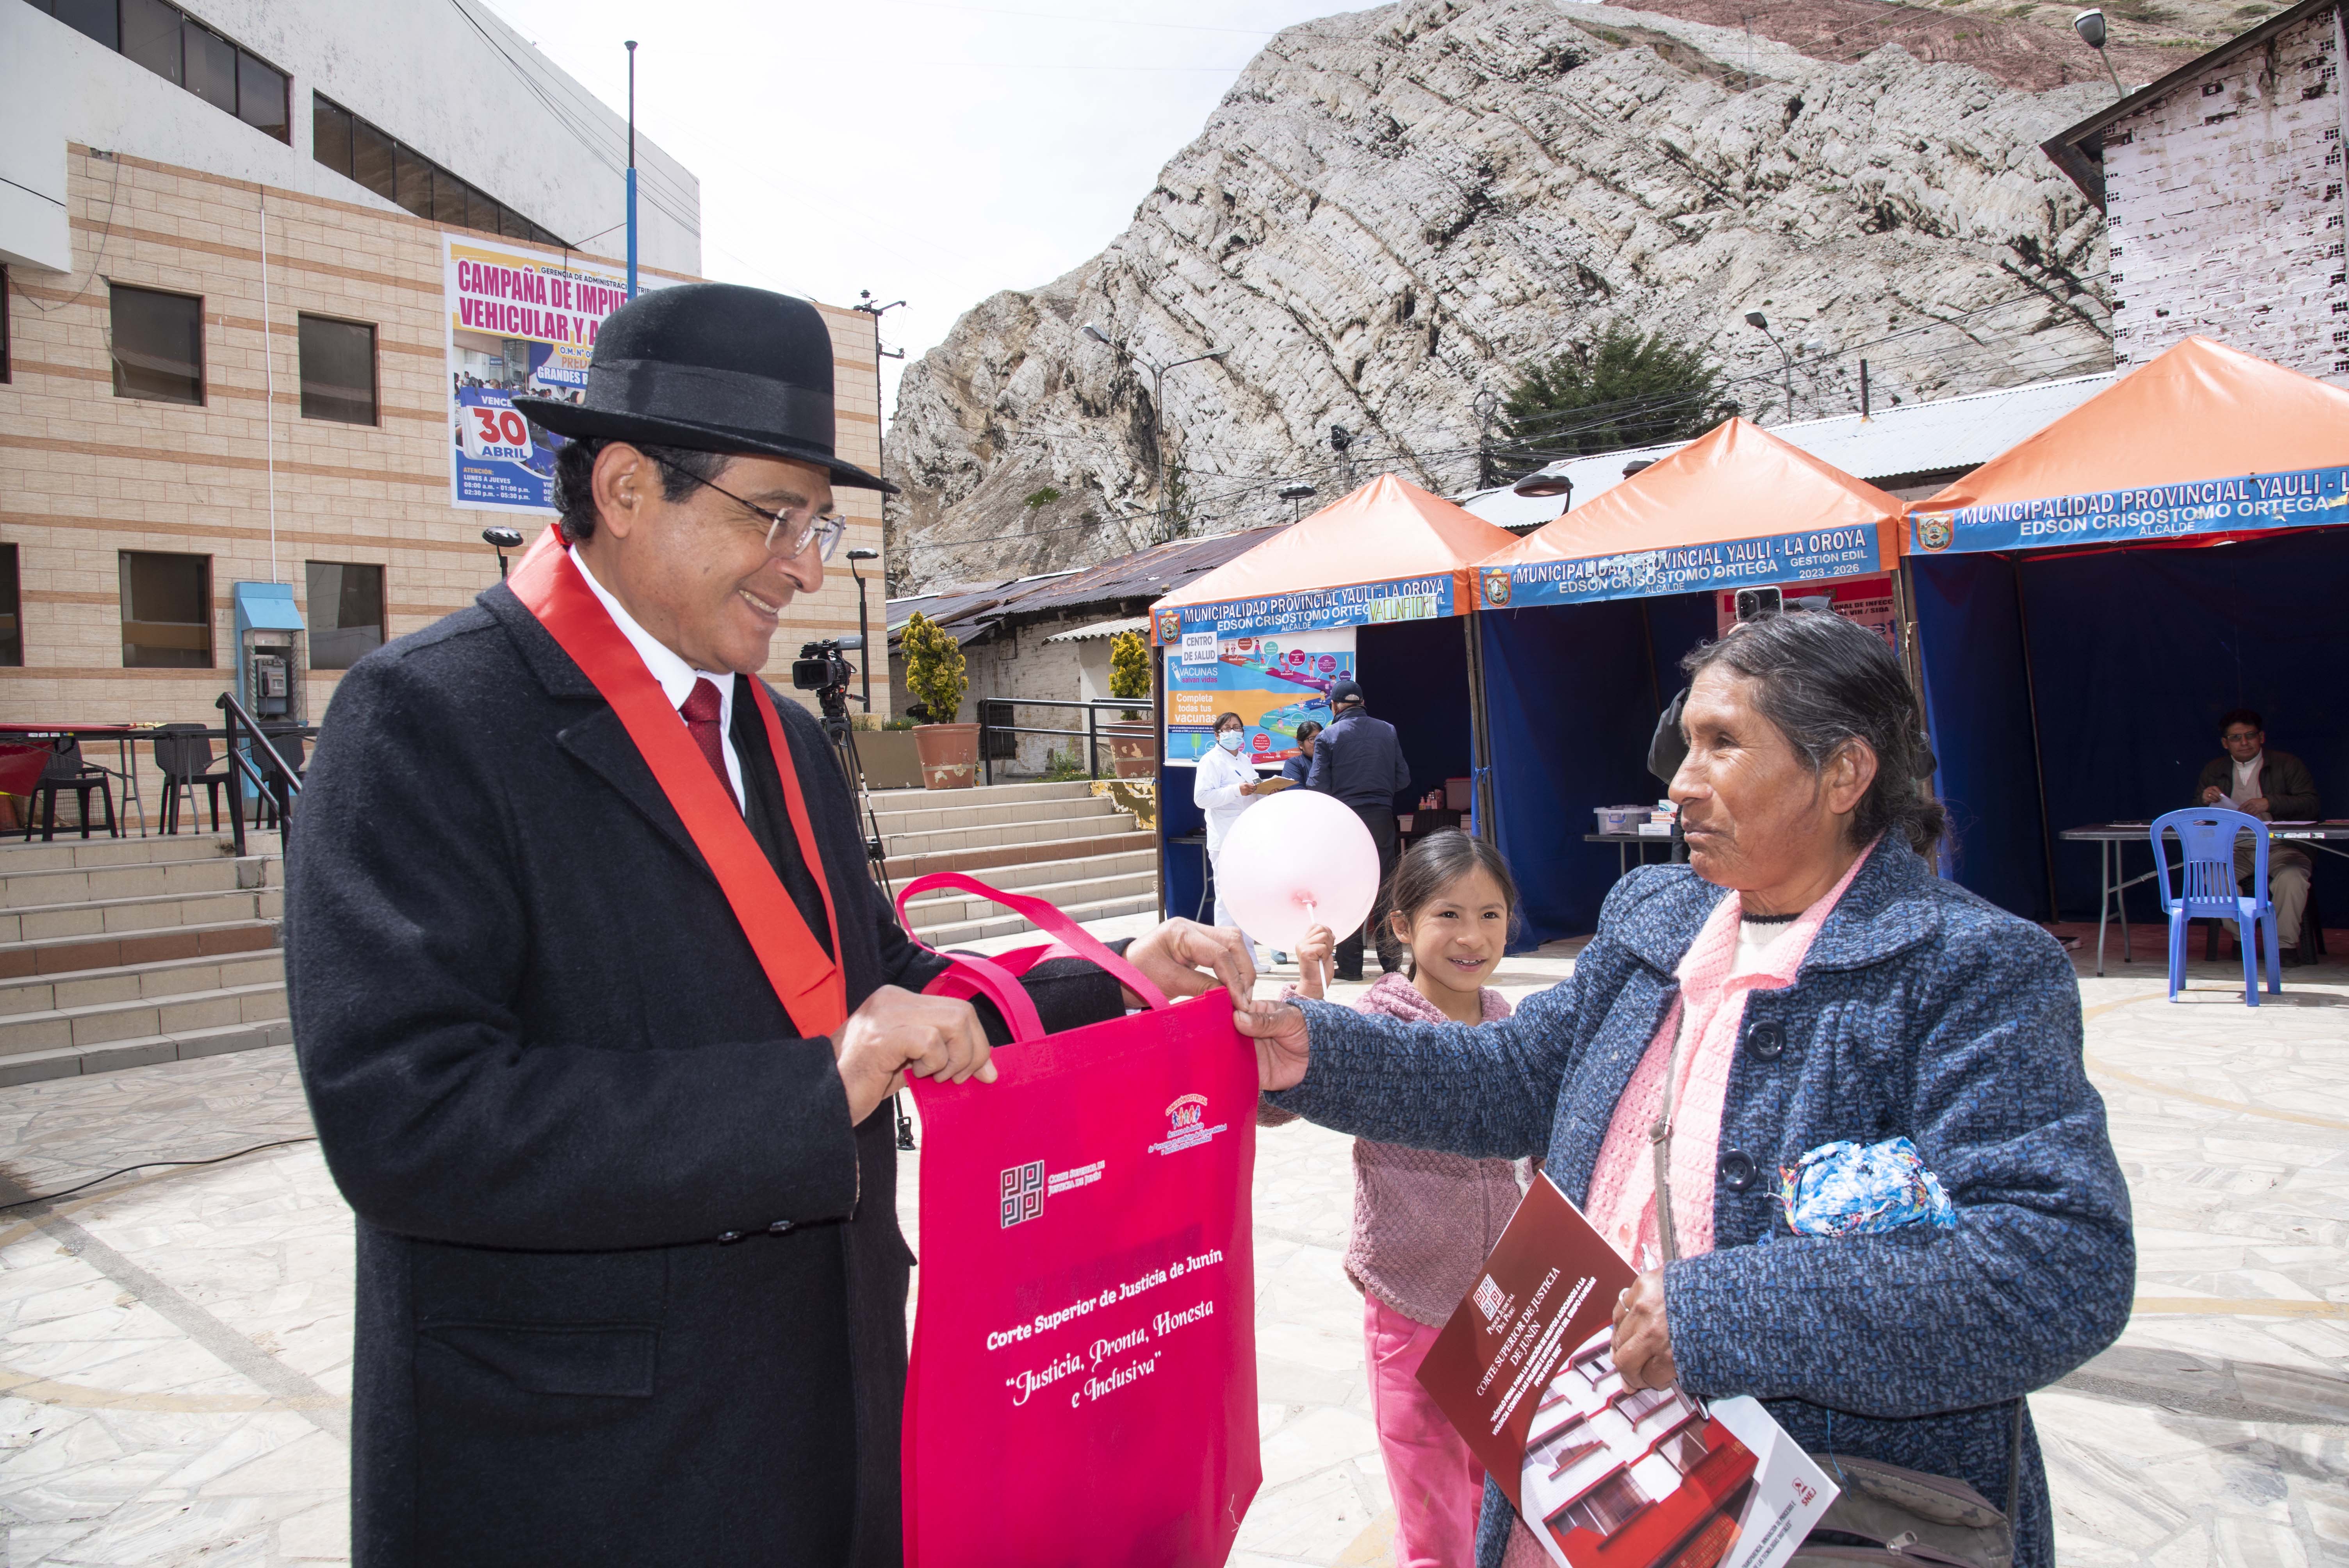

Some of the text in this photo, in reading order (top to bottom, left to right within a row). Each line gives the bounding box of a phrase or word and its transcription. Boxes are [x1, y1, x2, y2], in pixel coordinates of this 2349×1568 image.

[458, 260, 572, 310] CAMPAÑA DE
[541, 267, 573, 279] GERENCIA
[584, 276, 627, 290] ADMINISTRACI
[459, 297, 585, 344] VEHICULAR Y
[560, 347, 575, 356] O.M.
[537, 366, 581, 383] GRANDES
[481, 396, 513, 407] VENCE
[473, 407, 526, 446] 30
[481, 445, 528, 459] ABRIL
[463, 467, 494, 475] ATENCIÓN:
[1961, 473, 2320, 526] MUNICIPALIDAD PROVINCIAL YAULI
[2020, 496, 2329, 536] EDSON CRISOSTOMO ORTEGA
[2139, 522, 2195, 536] ALCALDE
[1516, 529, 1866, 584] MUNICIPALIDAD PROVINCIAL YAULI LA OROYA
[1559, 550, 1868, 594] EDSON CRISOSTOMO ORTEGA GESTION EDIL
[1645, 563, 1859, 594] ALCALDE 2023 2026
[1185, 600, 1267, 623] MUNICIPALIDAD
[1271, 592, 1338, 613] PROVINCIAL
[1403, 579, 1445, 596] OROYA
[1217, 608, 1330, 631] EDSON CRISOSTOMO
[1281, 622, 1312, 632] ALCALDE
[1187, 636, 1213, 647] CENTRO
[1184, 650, 1215, 661] DE SALUD
[1179, 667, 1218, 676] VACUNAS
[1176, 693, 1213, 704] Completa
[1175, 714, 1217, 723] vacunas
[1187, 1094, 1207, 1105] DISTRITAL
[987, 1249, 1223, 1351] Corte Superior de Justicia de Junín
[1578, 1276, 1597, 1302] FAMILIAR
[1567, 1299, 1581, 1319] GRUPO
[1476, 1267, 1560, 1396] CORTE SUPERIOR DE JUSTICIA
[1503, 1385, 1517, 1402] PENAL
[1513, 1372, 1525, 1388] PARA
[1521, 1365, 1529, 1375] LA
[1526, 1341, 1543, 1368] SANCIÓN
[1539, 1336, 1547, 1346] DE
[1543, 1317, 1559, 1340] DELITOS
[1556, 1288, 1578, 1320] ASOCIADOS
[1577, 1277, 1586, 1286] LA
[1510, 1320, 1541, 1366] DE JUNÍN
[1541, 1324, 1565, 1360] INTEGRANTES
[1006, 1301, 1214, 1406] “Justicia, Pronta, Honesta
[1538, 1355, 1545, 1363] E
[1071, 1351, 1161, 1408] e Inclusiva”
[1517, 1379, 1530, 1395] LAS
[1507, 1391, 1522, 1412] CONTRA
[1492, 1409, 1510, 1435] VIOLENCIA
[1801, 1487, 1817, 1506] SNEJ
